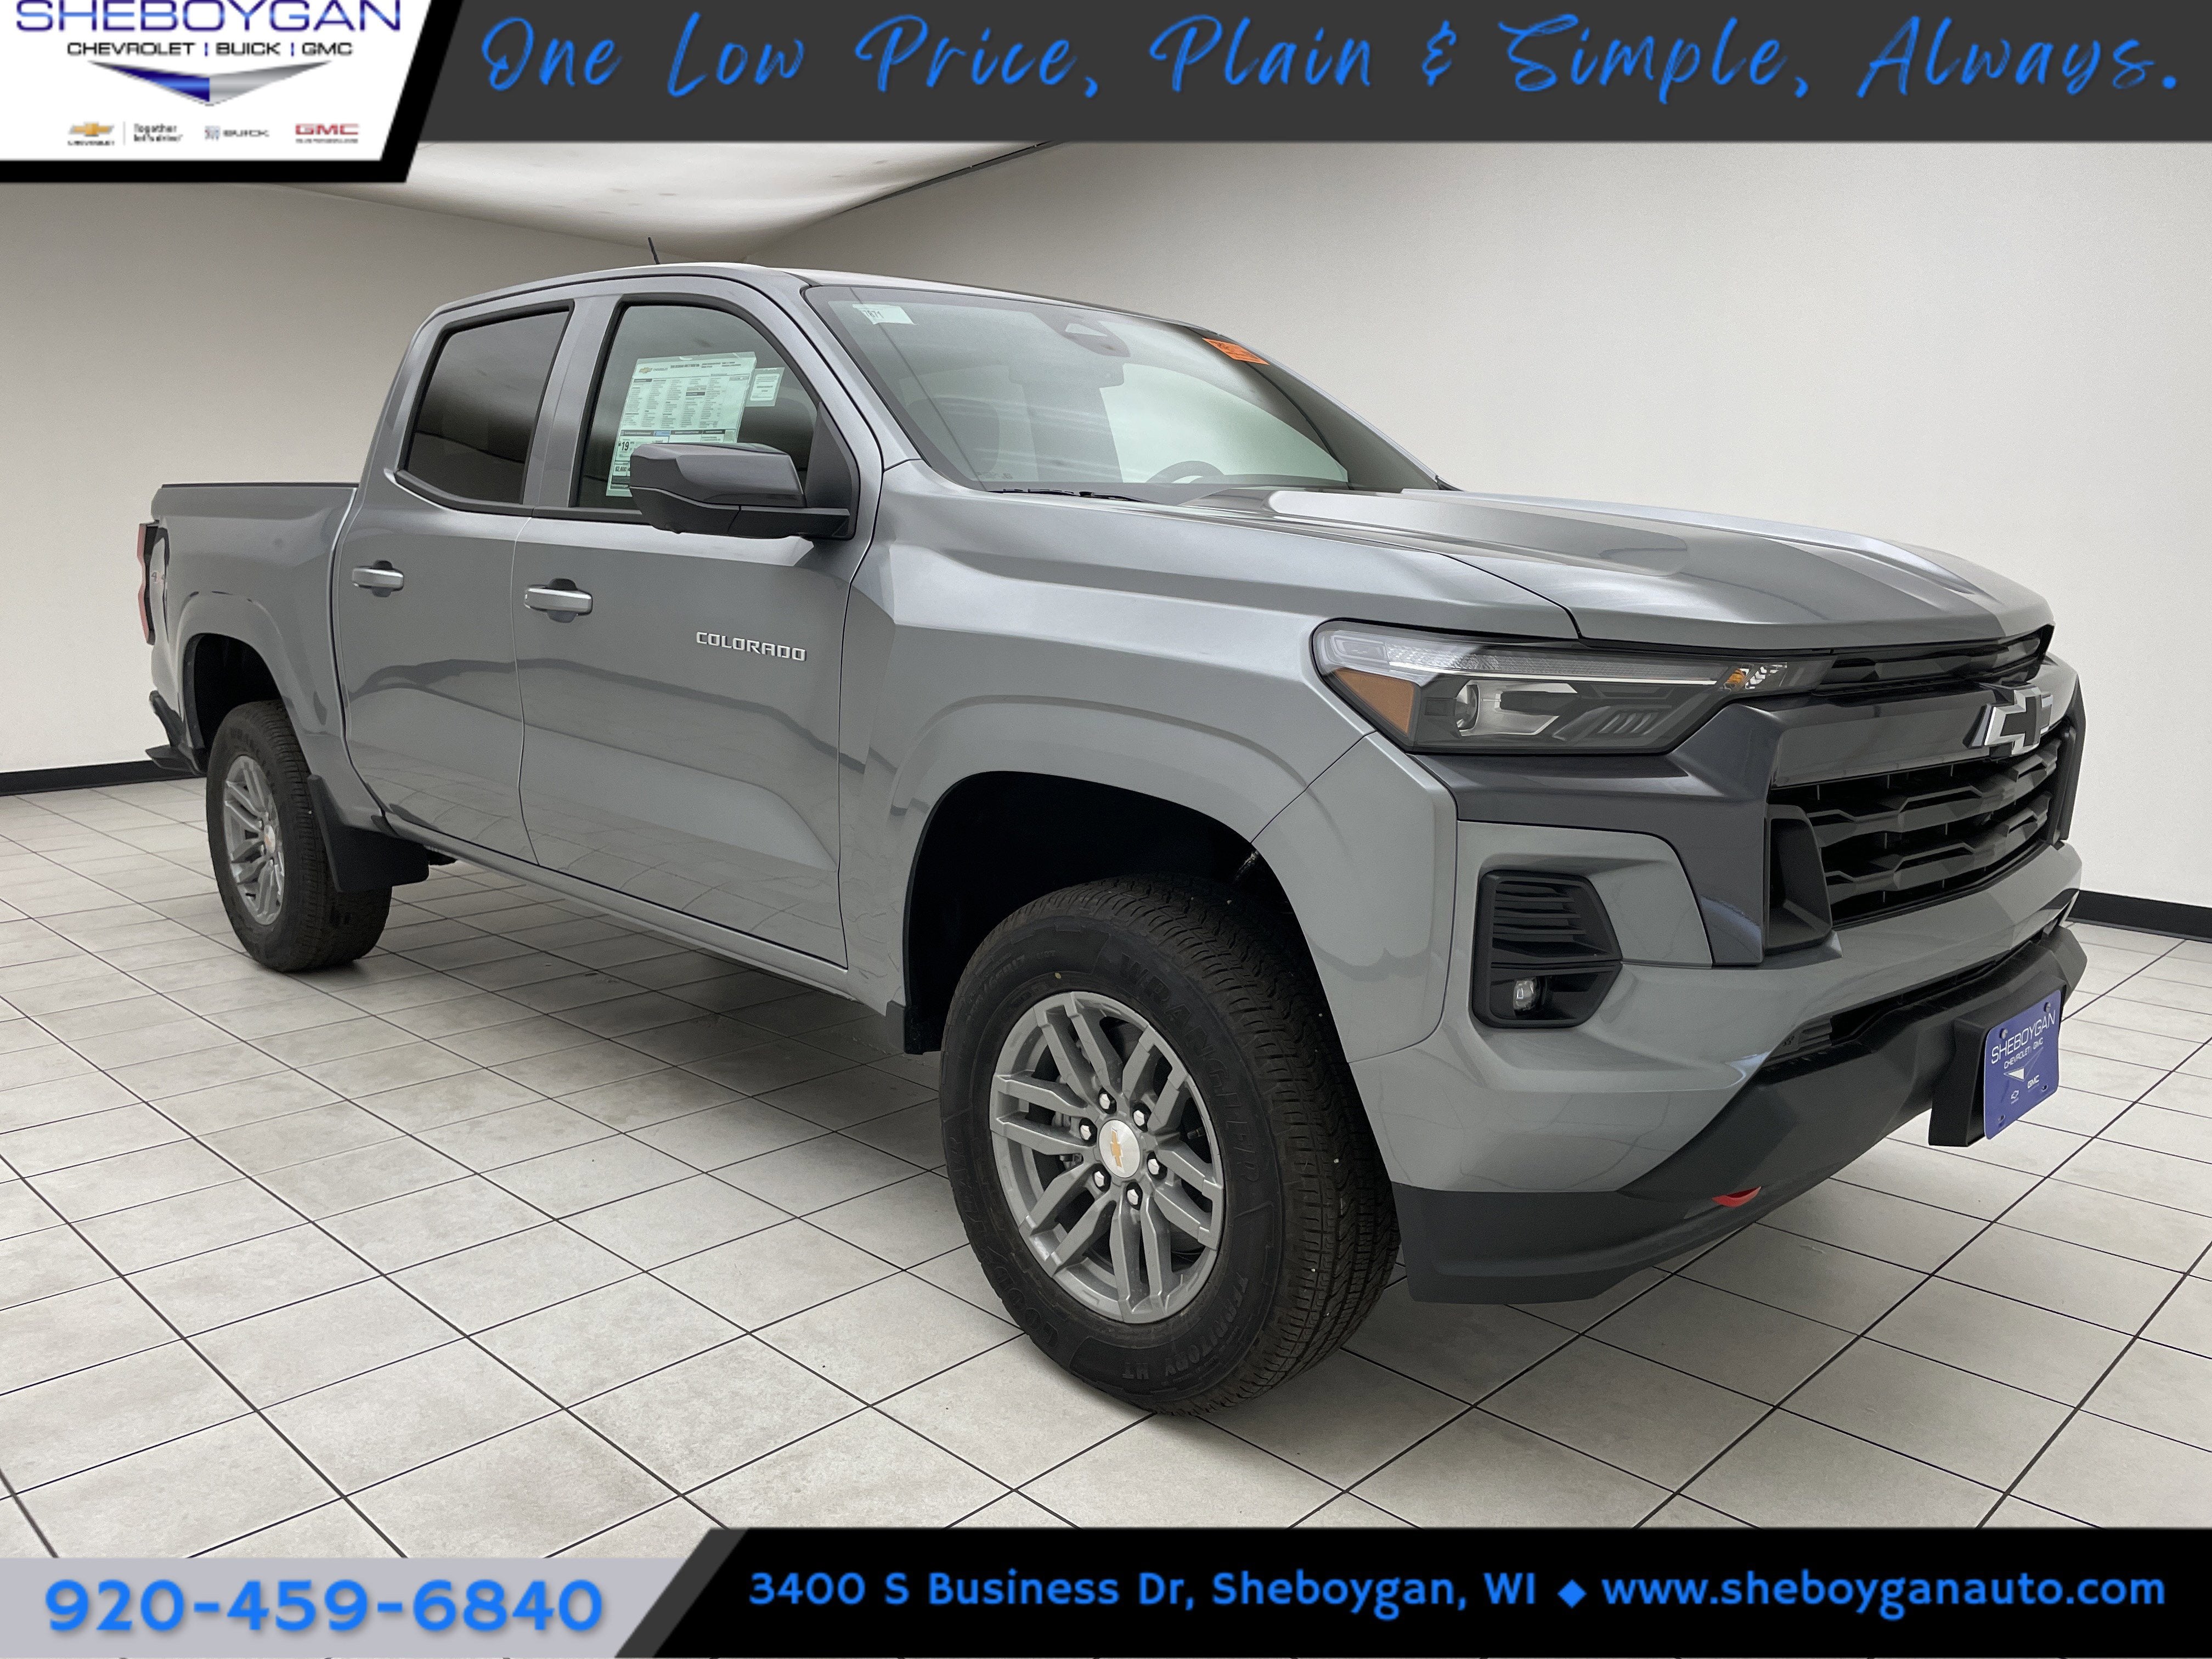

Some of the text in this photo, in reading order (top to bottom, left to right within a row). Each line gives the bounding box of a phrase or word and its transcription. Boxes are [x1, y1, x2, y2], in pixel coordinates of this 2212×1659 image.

[621, 441, 629, 451] 19
[696, 631, 807, 662] COLORADO
[1991, 1009, 2056, 1065] SHEBOYGAN
[1119, 952, 1261, 1182] WRANGLER
[2004, 1037, 2044, 1069] CHEVROLET GMC
[2027, 1074, 2040, 1089] GMC
